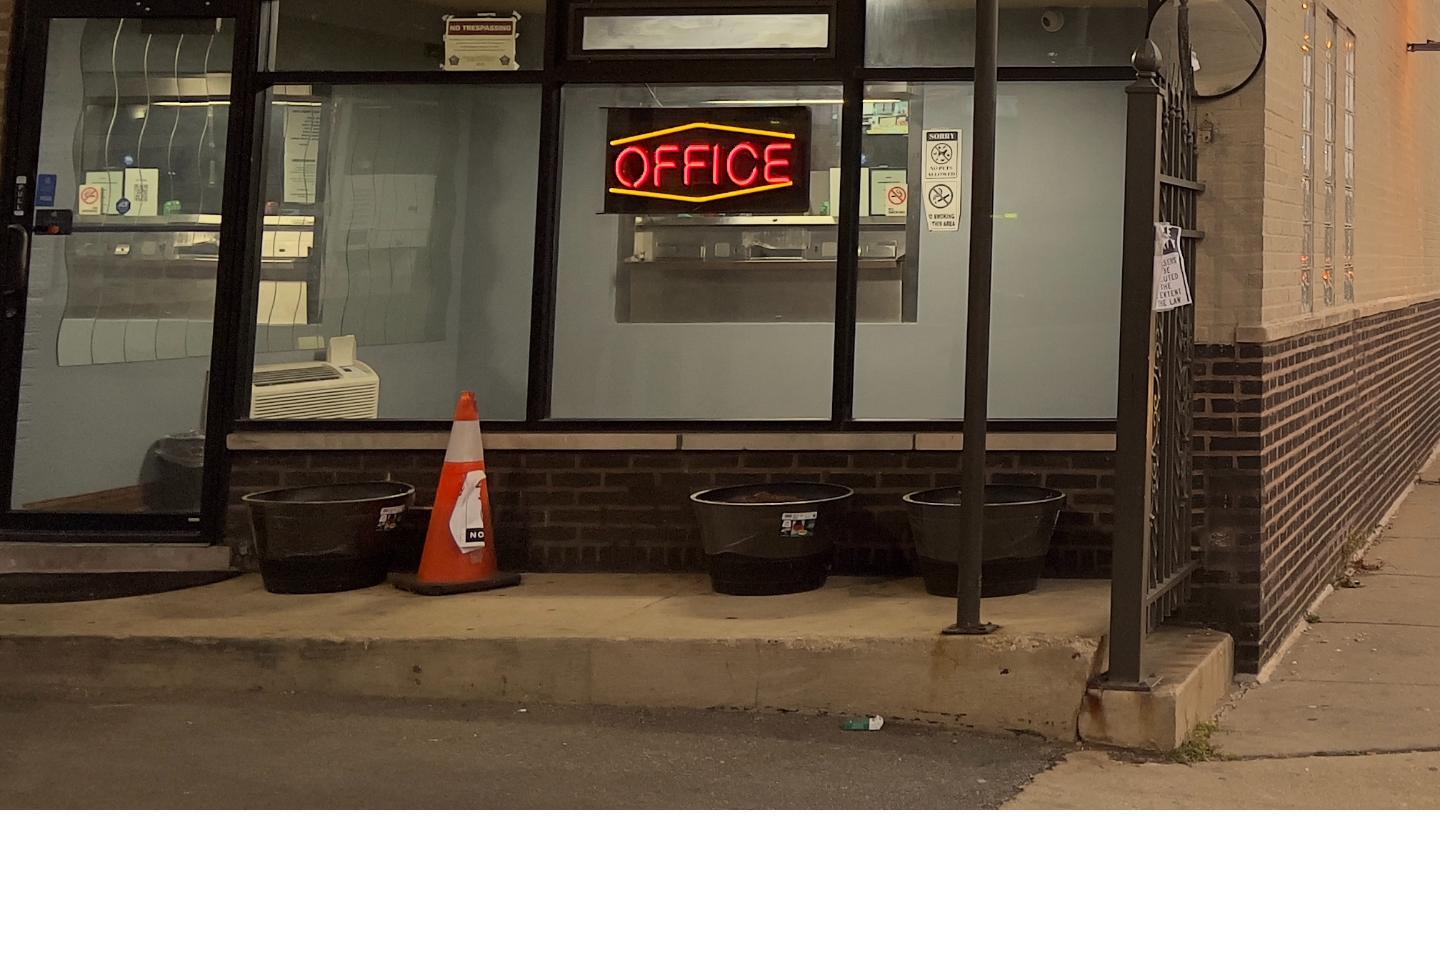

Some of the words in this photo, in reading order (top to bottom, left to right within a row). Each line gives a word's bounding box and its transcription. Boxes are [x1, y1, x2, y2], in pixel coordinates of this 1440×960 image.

[928, 132, 955, 140] SORRY
[615, 142, 792, 188] OFFICE
[1163, 273, 1178, 283] UTED
[469, 530, 485, 539] NO
